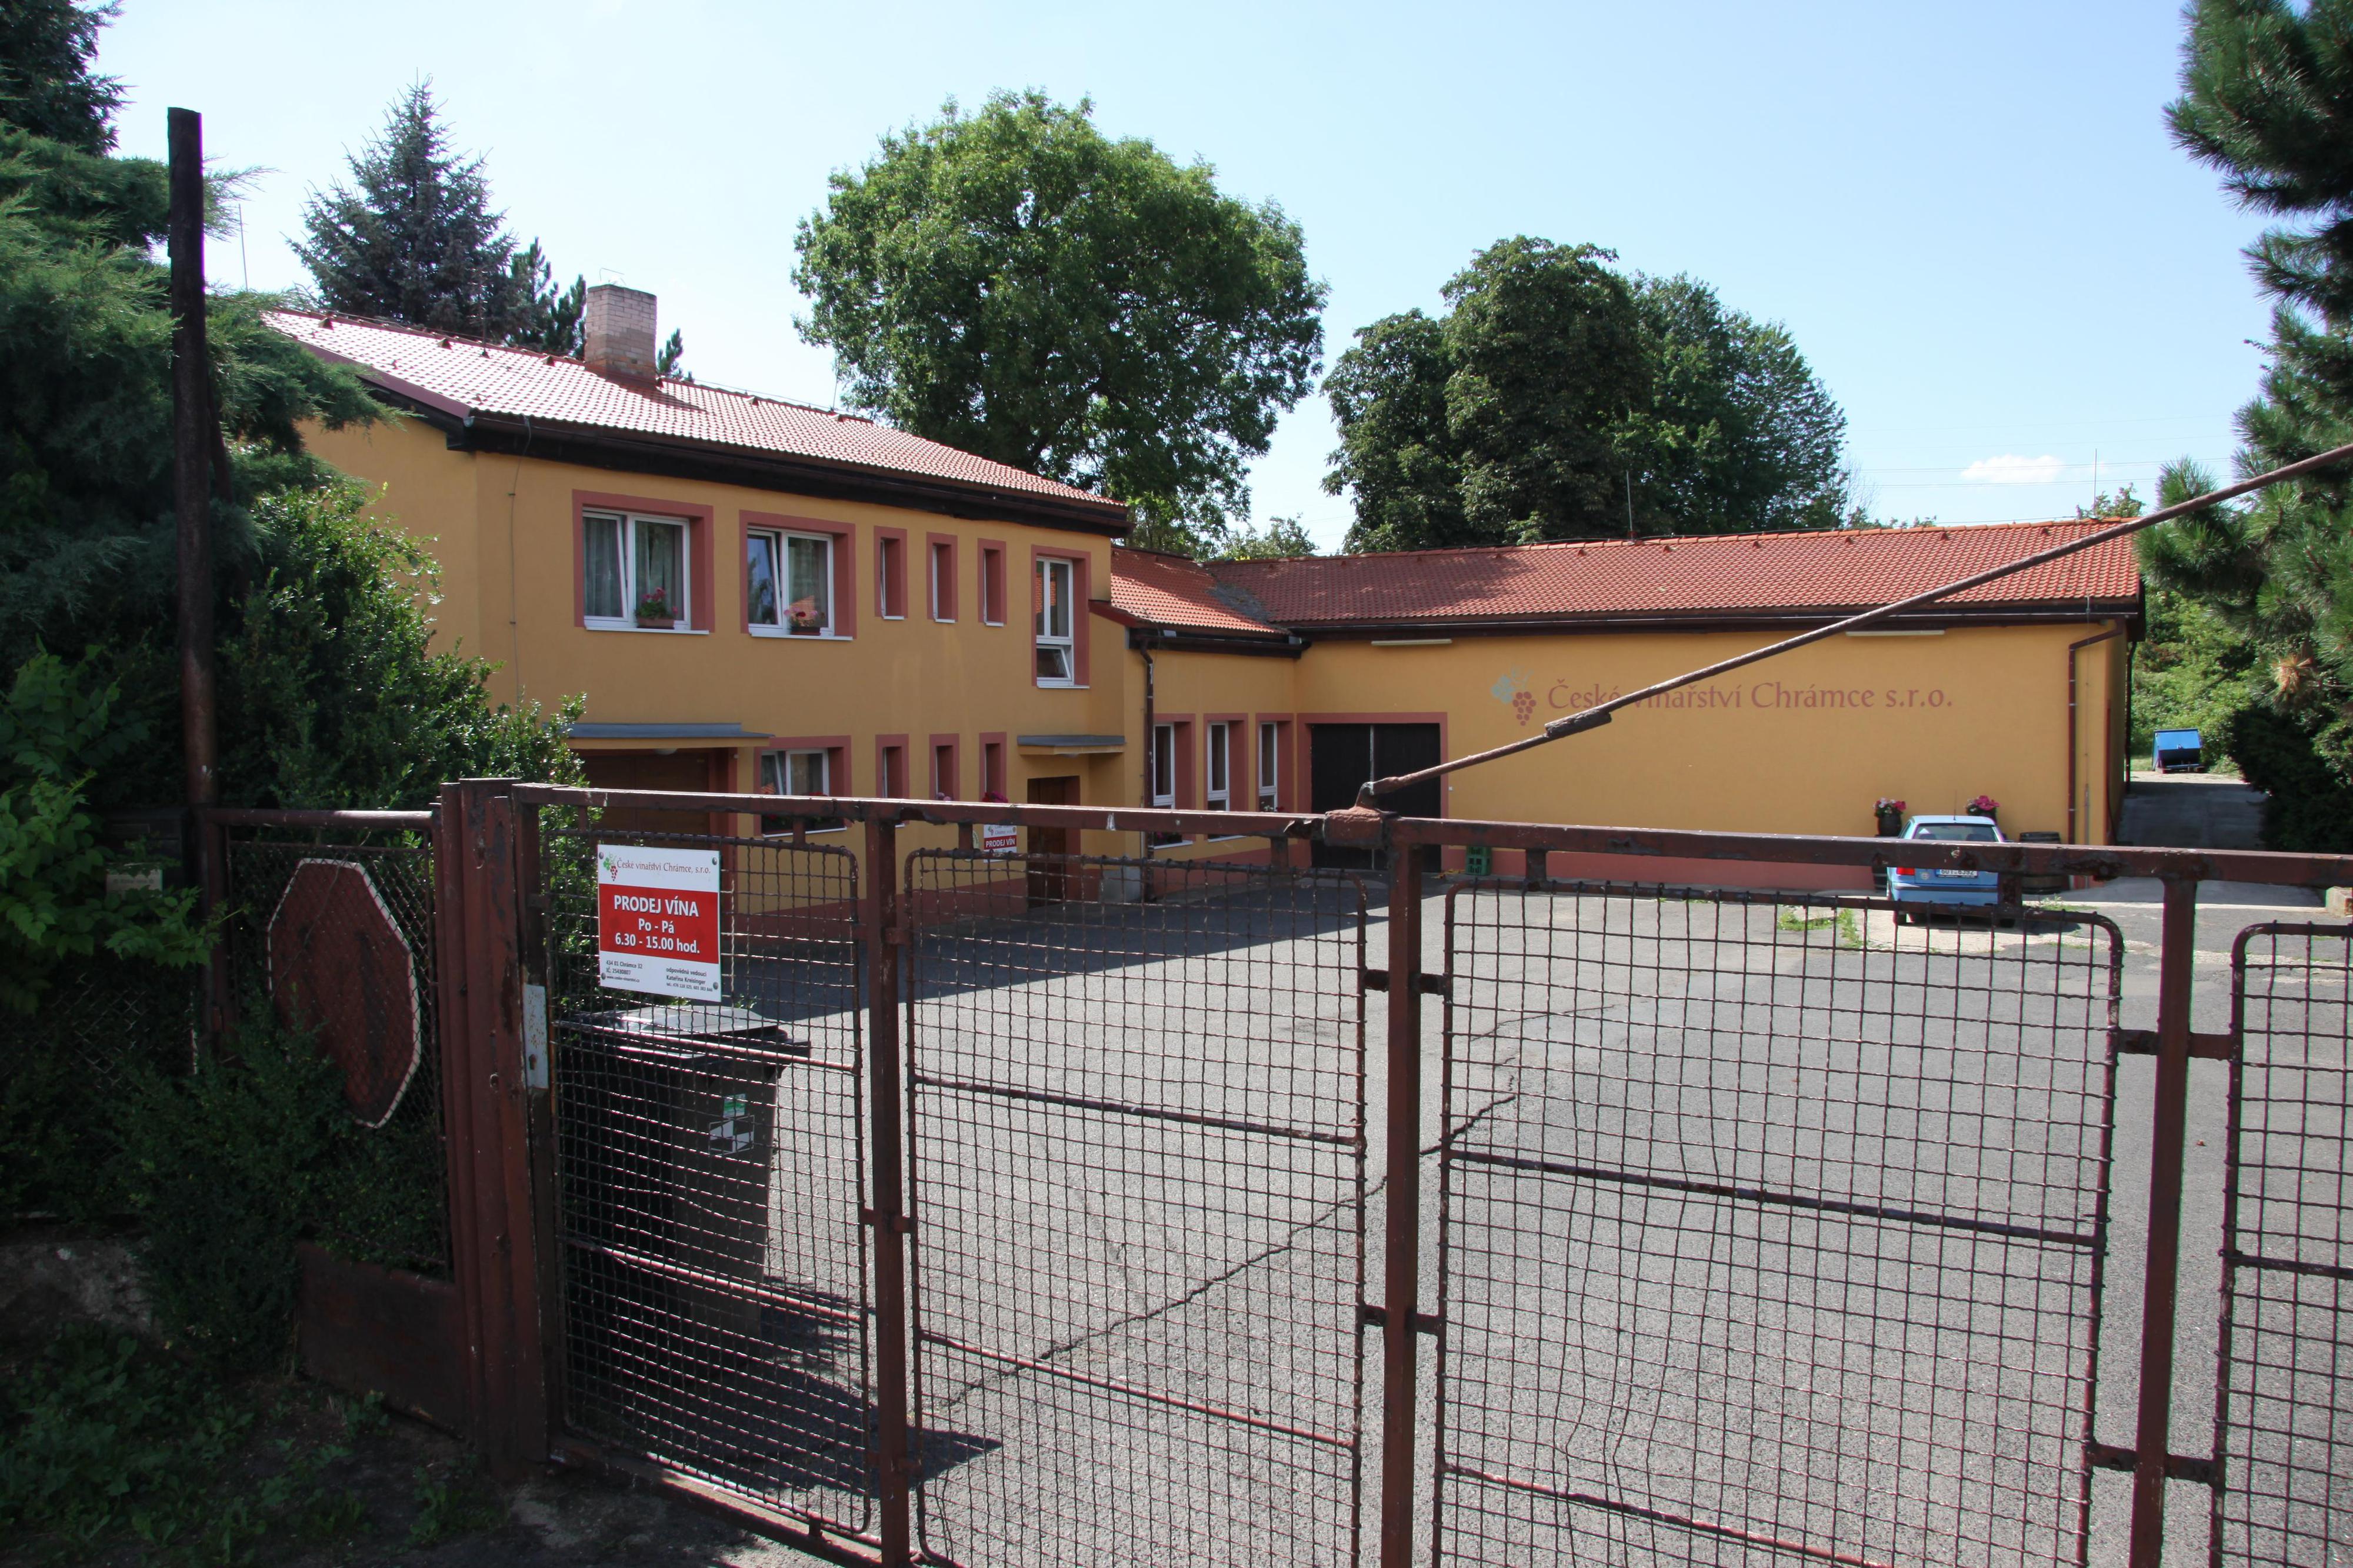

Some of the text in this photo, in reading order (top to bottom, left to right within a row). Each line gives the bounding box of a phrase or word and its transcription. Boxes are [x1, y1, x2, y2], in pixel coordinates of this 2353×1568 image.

[1750, 682, 1875, 708] Chrámce
[1885, 688, 1953, 708] s.r.o.
[617, 858, 634, 869] České
[636, 861, 661, 871] vinařství
[663, 862, 694, 874] Chrámce,
[614, 895, 699, 918] PRODEJ VÍNA
[638, 918, 652, 932] Po
[662, 920, 675, 934] Pá
[615, 932, 636, 946] 6.30
[646, 936, 674, 951] 15.00
[676, 939, 700, 953] hod.
[684, 977, 706, 986] Kreisinger
